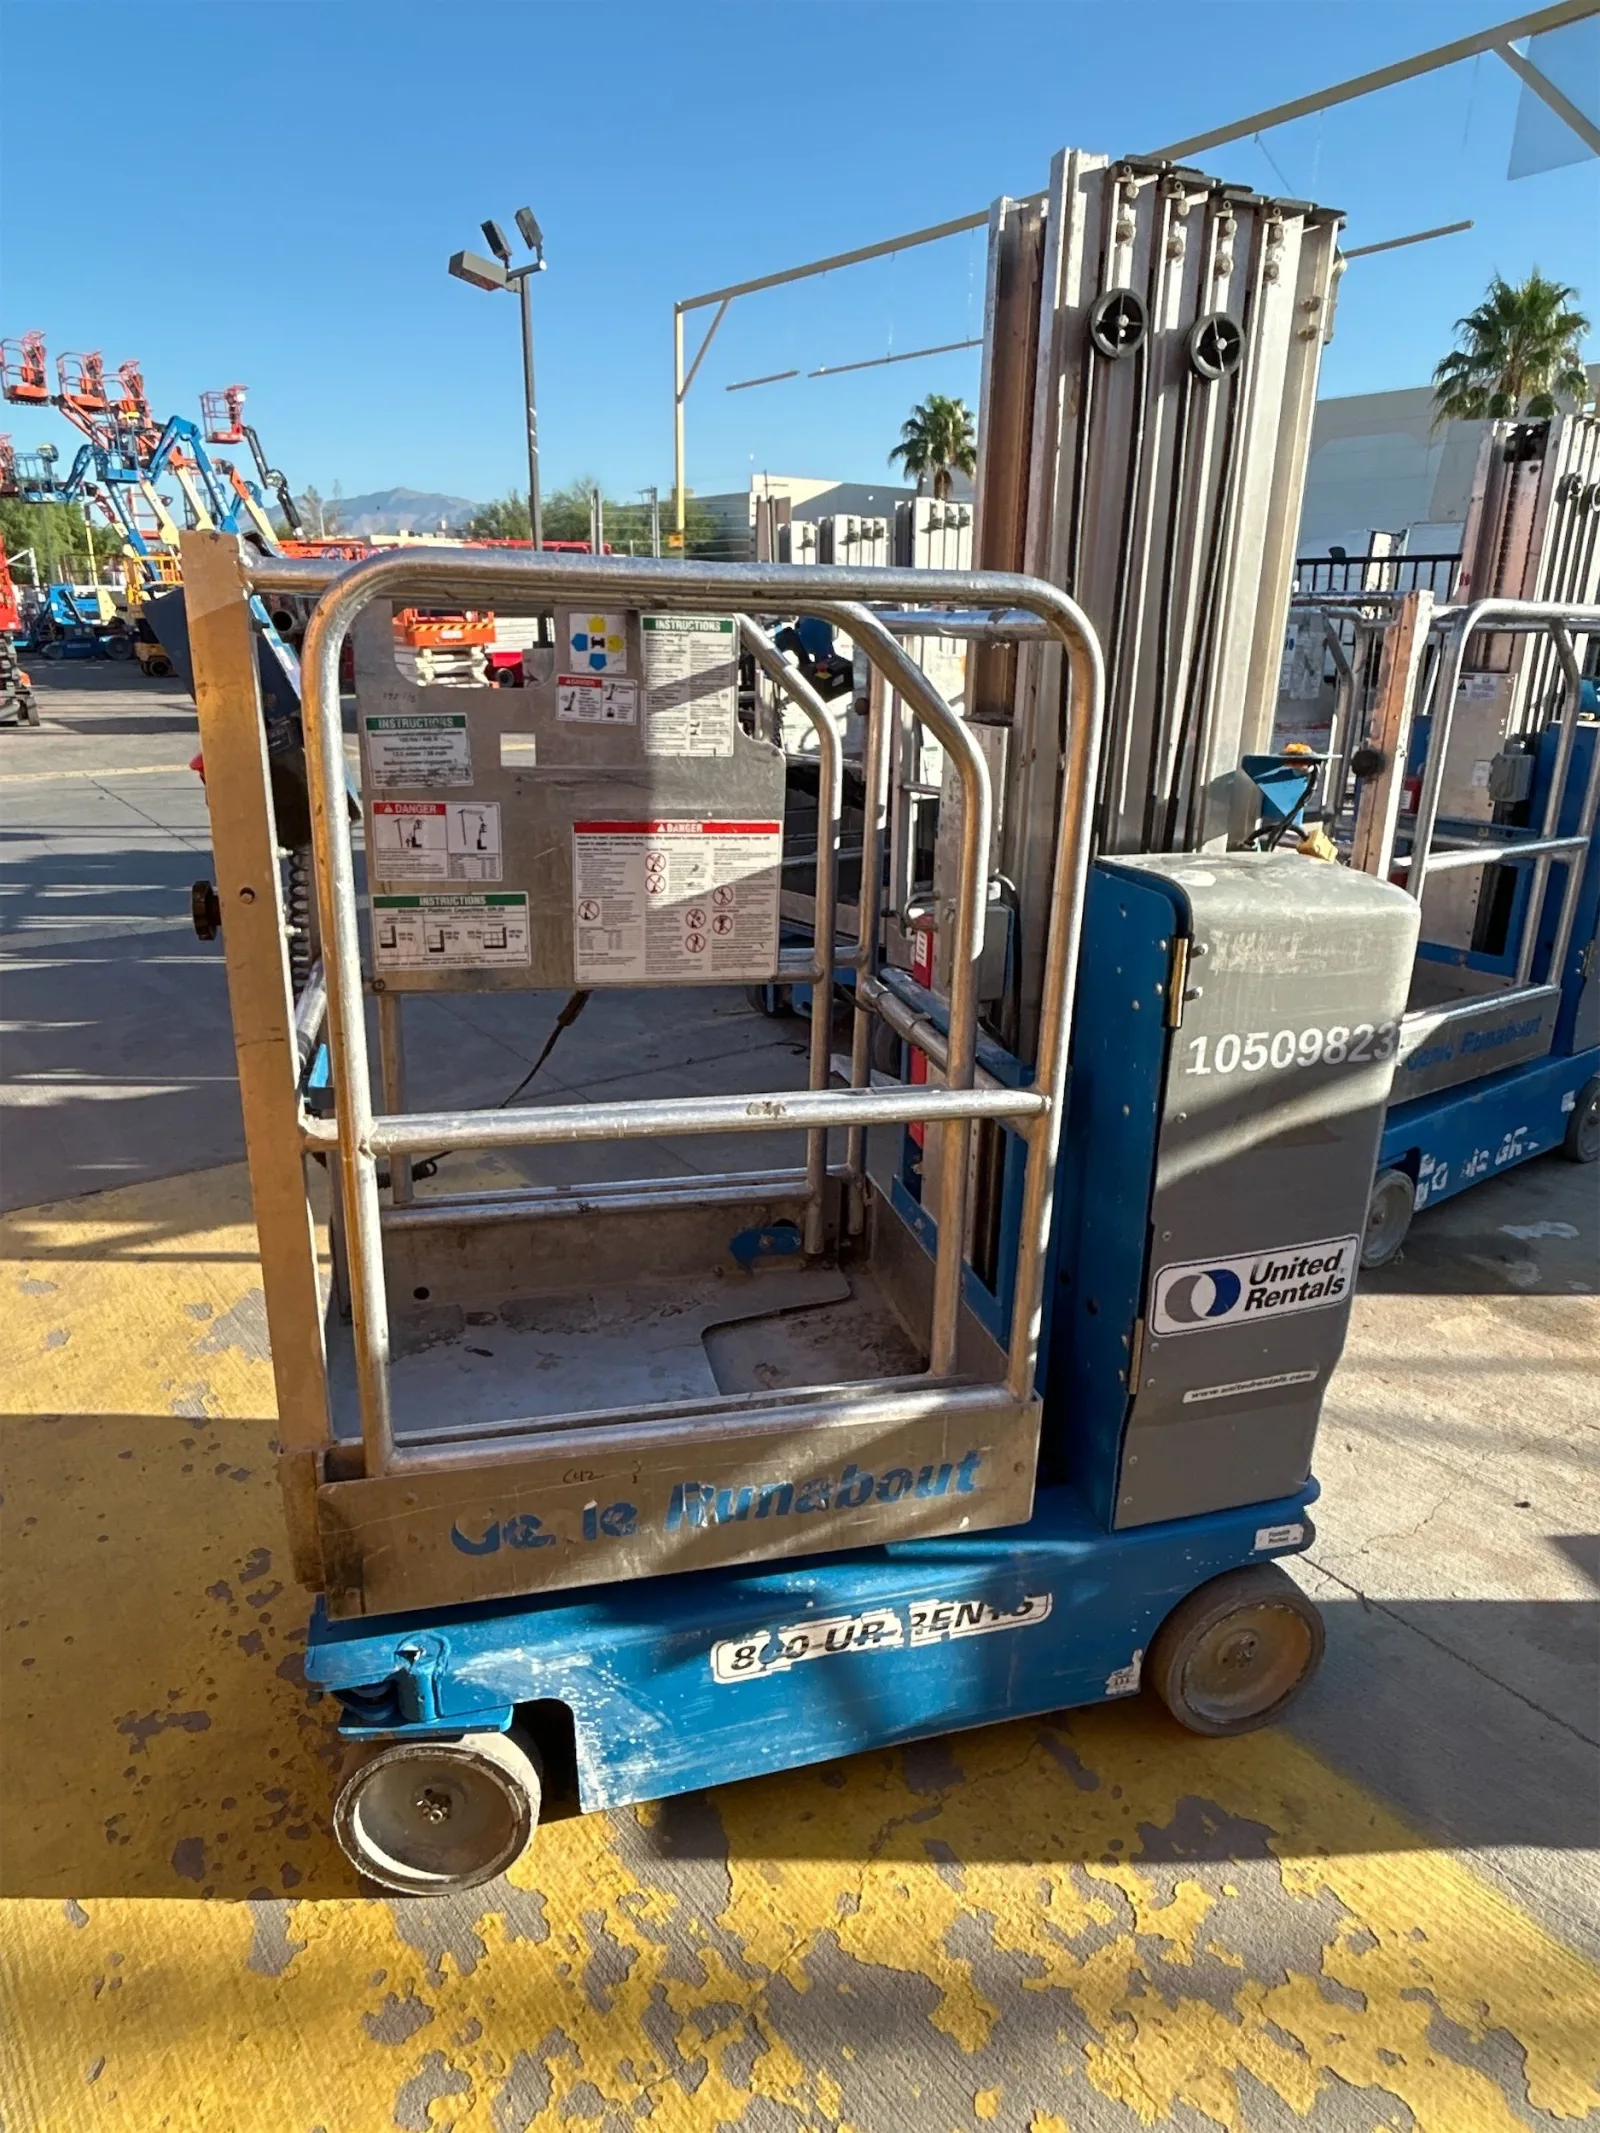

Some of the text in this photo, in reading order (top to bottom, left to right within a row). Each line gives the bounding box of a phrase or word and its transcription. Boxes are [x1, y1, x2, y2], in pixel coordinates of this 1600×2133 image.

[655, 619, 721, 631] INSTRUCTIONS
[395, 804, 437, 814] DANGER
[667, 823, 703, 833] DANGER
[419, 896, 486, 906] INSTRUCTIONS
[1185, 1020, 1398, 1075] 10509823
[1249, 1247, 1344, 1286] United
[1244, 1274, 1346, 1312] Rentals
[663, 1449, 982, 1532] Runabout
